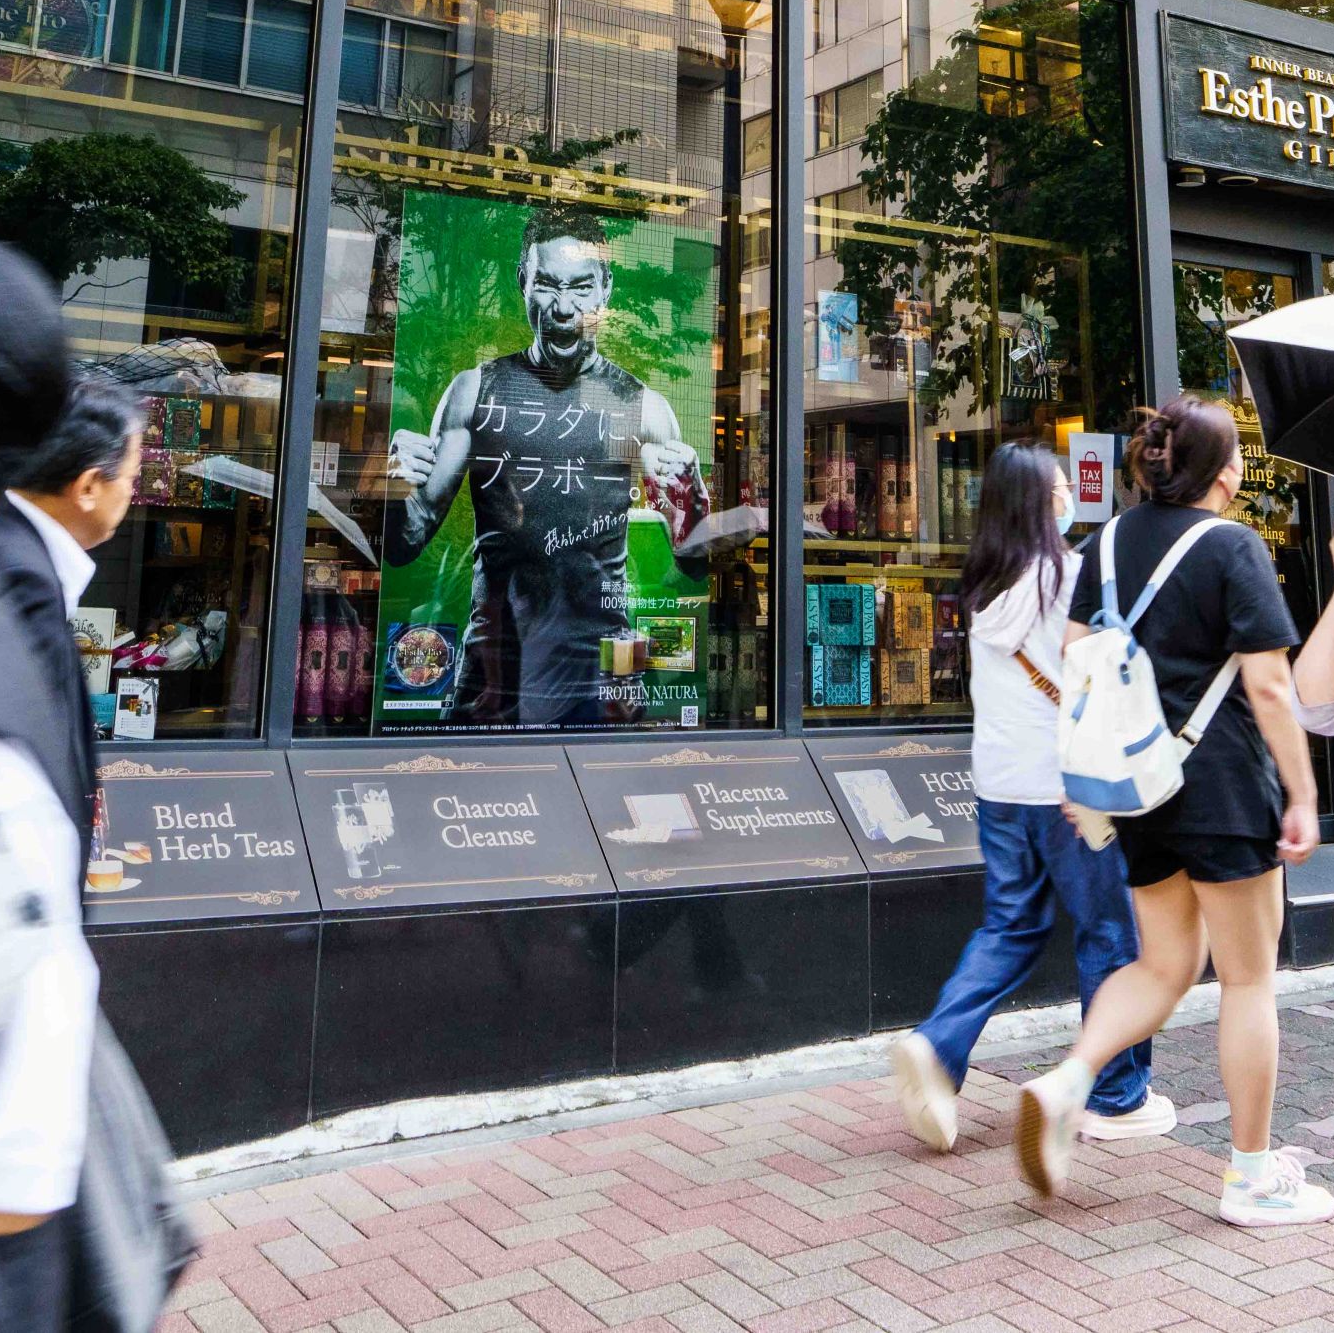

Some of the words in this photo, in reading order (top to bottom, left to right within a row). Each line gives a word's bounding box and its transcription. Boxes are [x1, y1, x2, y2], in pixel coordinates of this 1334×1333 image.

[1248, 54, 1302, 79] INNER
[396, 96, 476, 124] INNER
[1198, 67, 1307, 130] Esthe
[475, 395, 643, 447] カラダに、
[475, 450, 641, 502] ブラボー。
[1081, 469, 1100, 480] TAX
[1081, 482, 1102, 494] FREE
[598, 685, 650, 701] PROTEIN
[652, 684, 699, 701] NATURA
[693, 782, 789, 805] Placenta
[919, 770, 975, 793] HGH
[152, 802, 236, 830] Blend
[432, 793, 540, 820] Charcoal
[706, 806, 836, 837] Supplements
[157, 835, 231, 862] Herb
[234, 831, 296, 858] Teas
[441, 824, 537, 849] Cleanse
